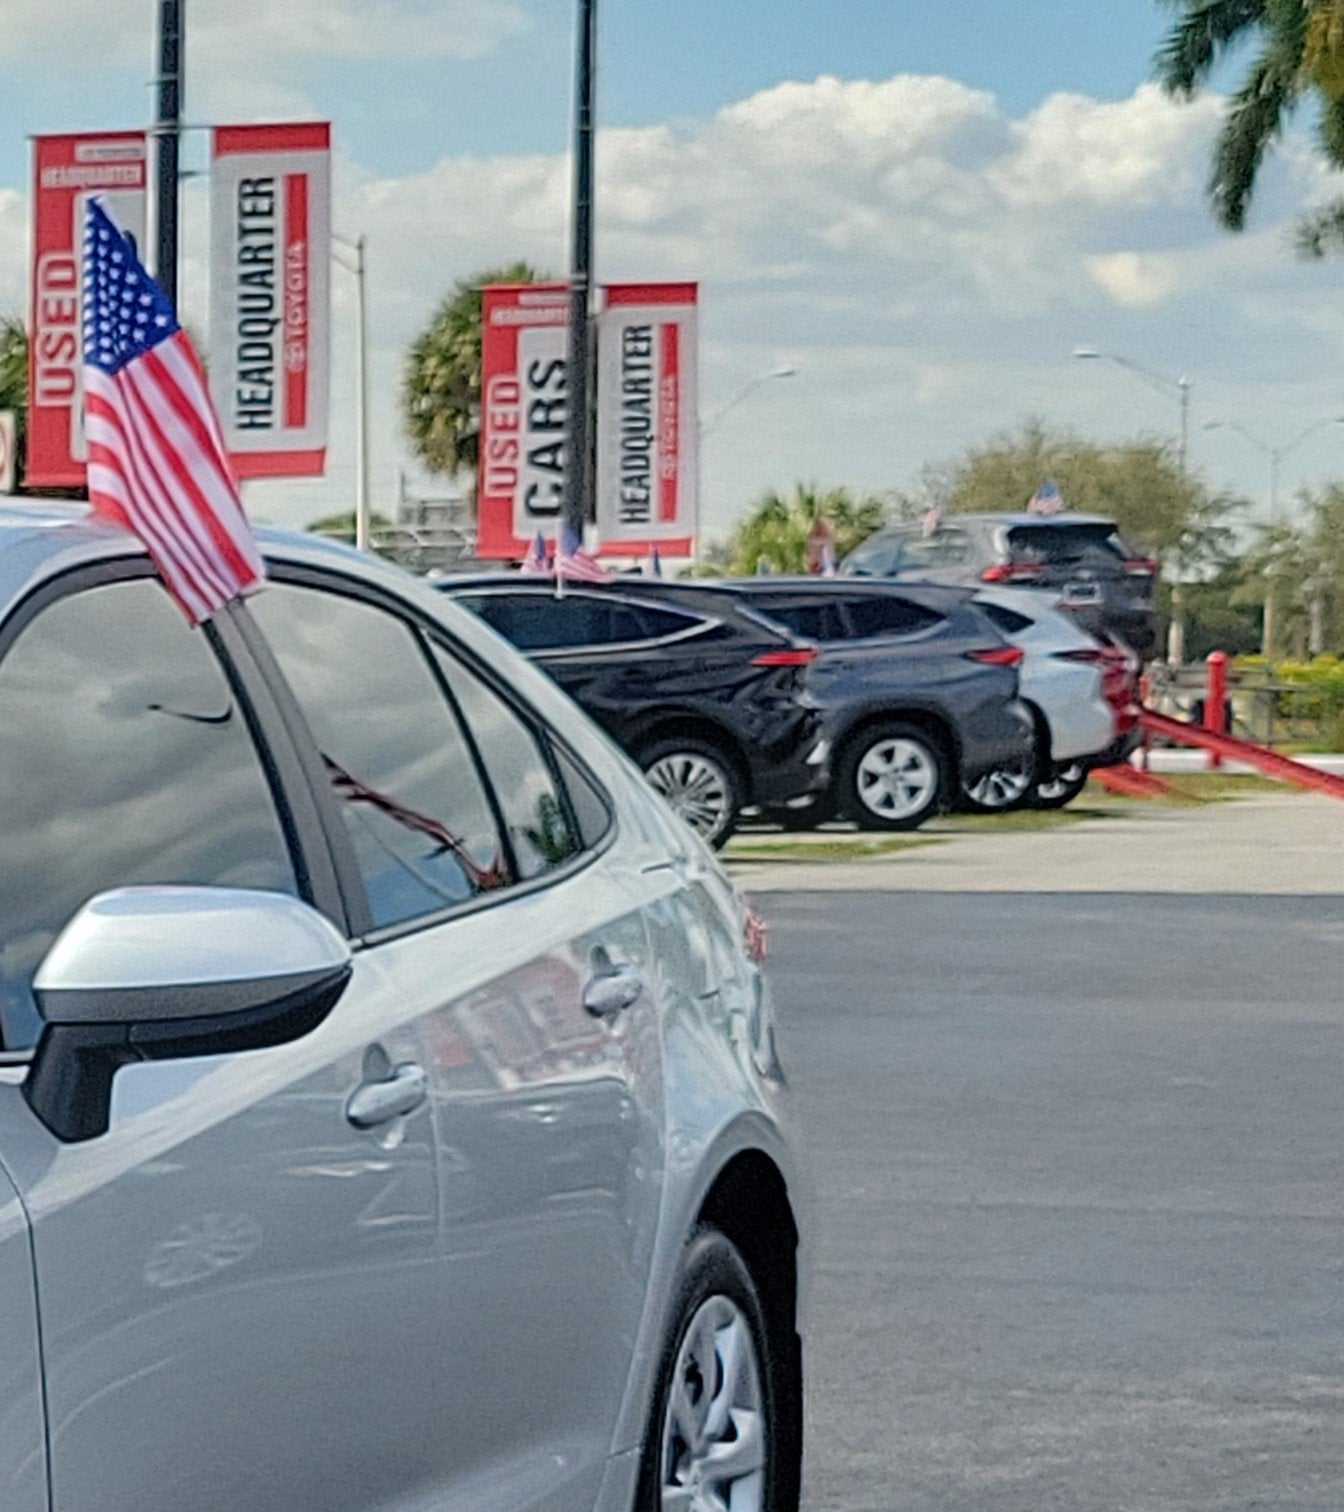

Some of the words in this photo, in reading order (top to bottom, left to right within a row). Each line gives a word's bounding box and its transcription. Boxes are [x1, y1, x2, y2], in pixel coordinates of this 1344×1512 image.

[39, 259, 78, 399] USED
[236, 176, 280, 430] HEADQUARTER
[489, 381, 520, 492] USED
[525, 358, 567, 517] CARS
[619, 324, 654, 524] HEADQUARTER
